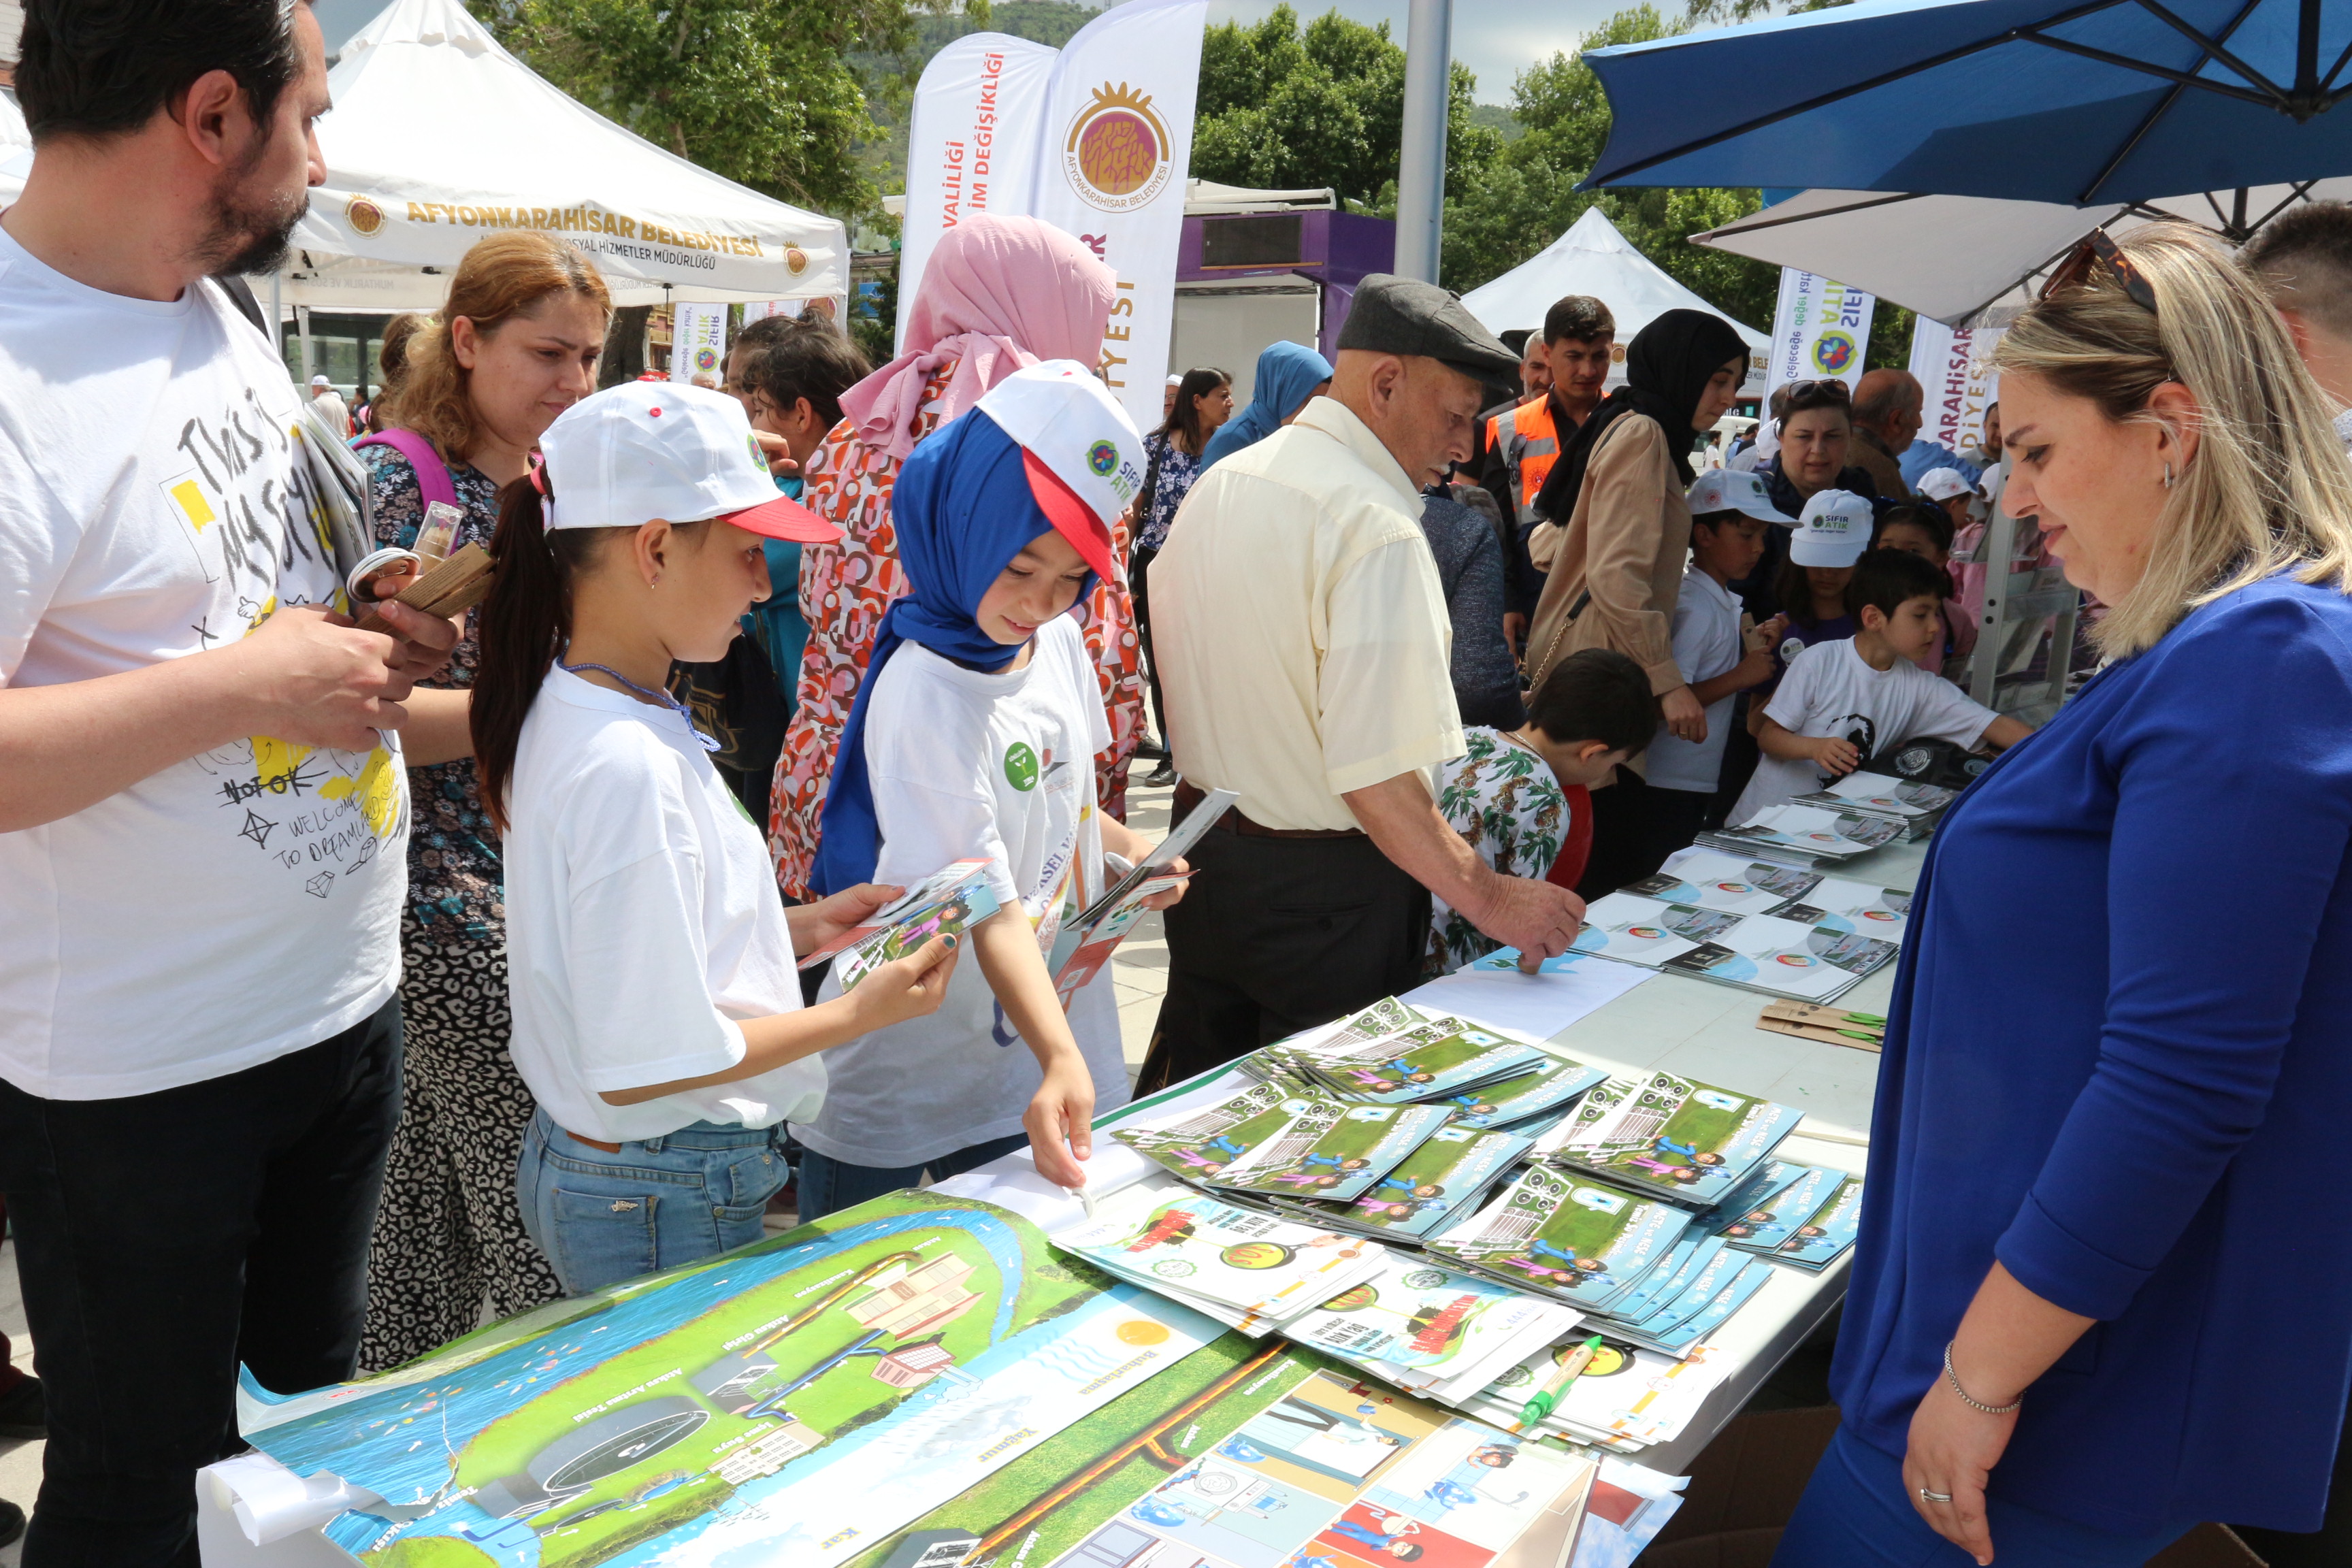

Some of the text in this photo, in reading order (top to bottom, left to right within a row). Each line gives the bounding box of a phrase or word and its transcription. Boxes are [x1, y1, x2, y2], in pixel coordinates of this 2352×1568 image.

[973, 53, 1004, 175] DEĞİŞİKLİĞİ
[943, 142, 964, 228] VALİLİĞİ
[1067, 156, 1169, 208] AFYONKARAHİSAR BELEDİYESİ
[407, 202, 636, 239] AFYONKARAHİSAR
[640, 220, 764, 258] BELEDİYESİ
[564, 238, 716, 271] OSYAL HİZMETLER MÜDÜRLÜĞÜ
[289, 787, 364, 838] WELCOME
[1648, 1208, 1669, 1229] METE
[793, 1269, 855, 1298] Kanalizasyon
[753, 1314, 789, 1335] Atıksu
[1078, 1350, 1160, 1395] Buharlaşma
[1243, 1358, 1296, 1396] Kanalizasyon
[572, 1368, 683, 1423] Atıksu Arıtma Tesisi
[712, 1437, 745, 1454] Suyu
[977, 1427, 1039, 1463] Yağmur
[436, 1486, 478, 1509] Temiz
[821, 1527, 861, 1550] Kar
